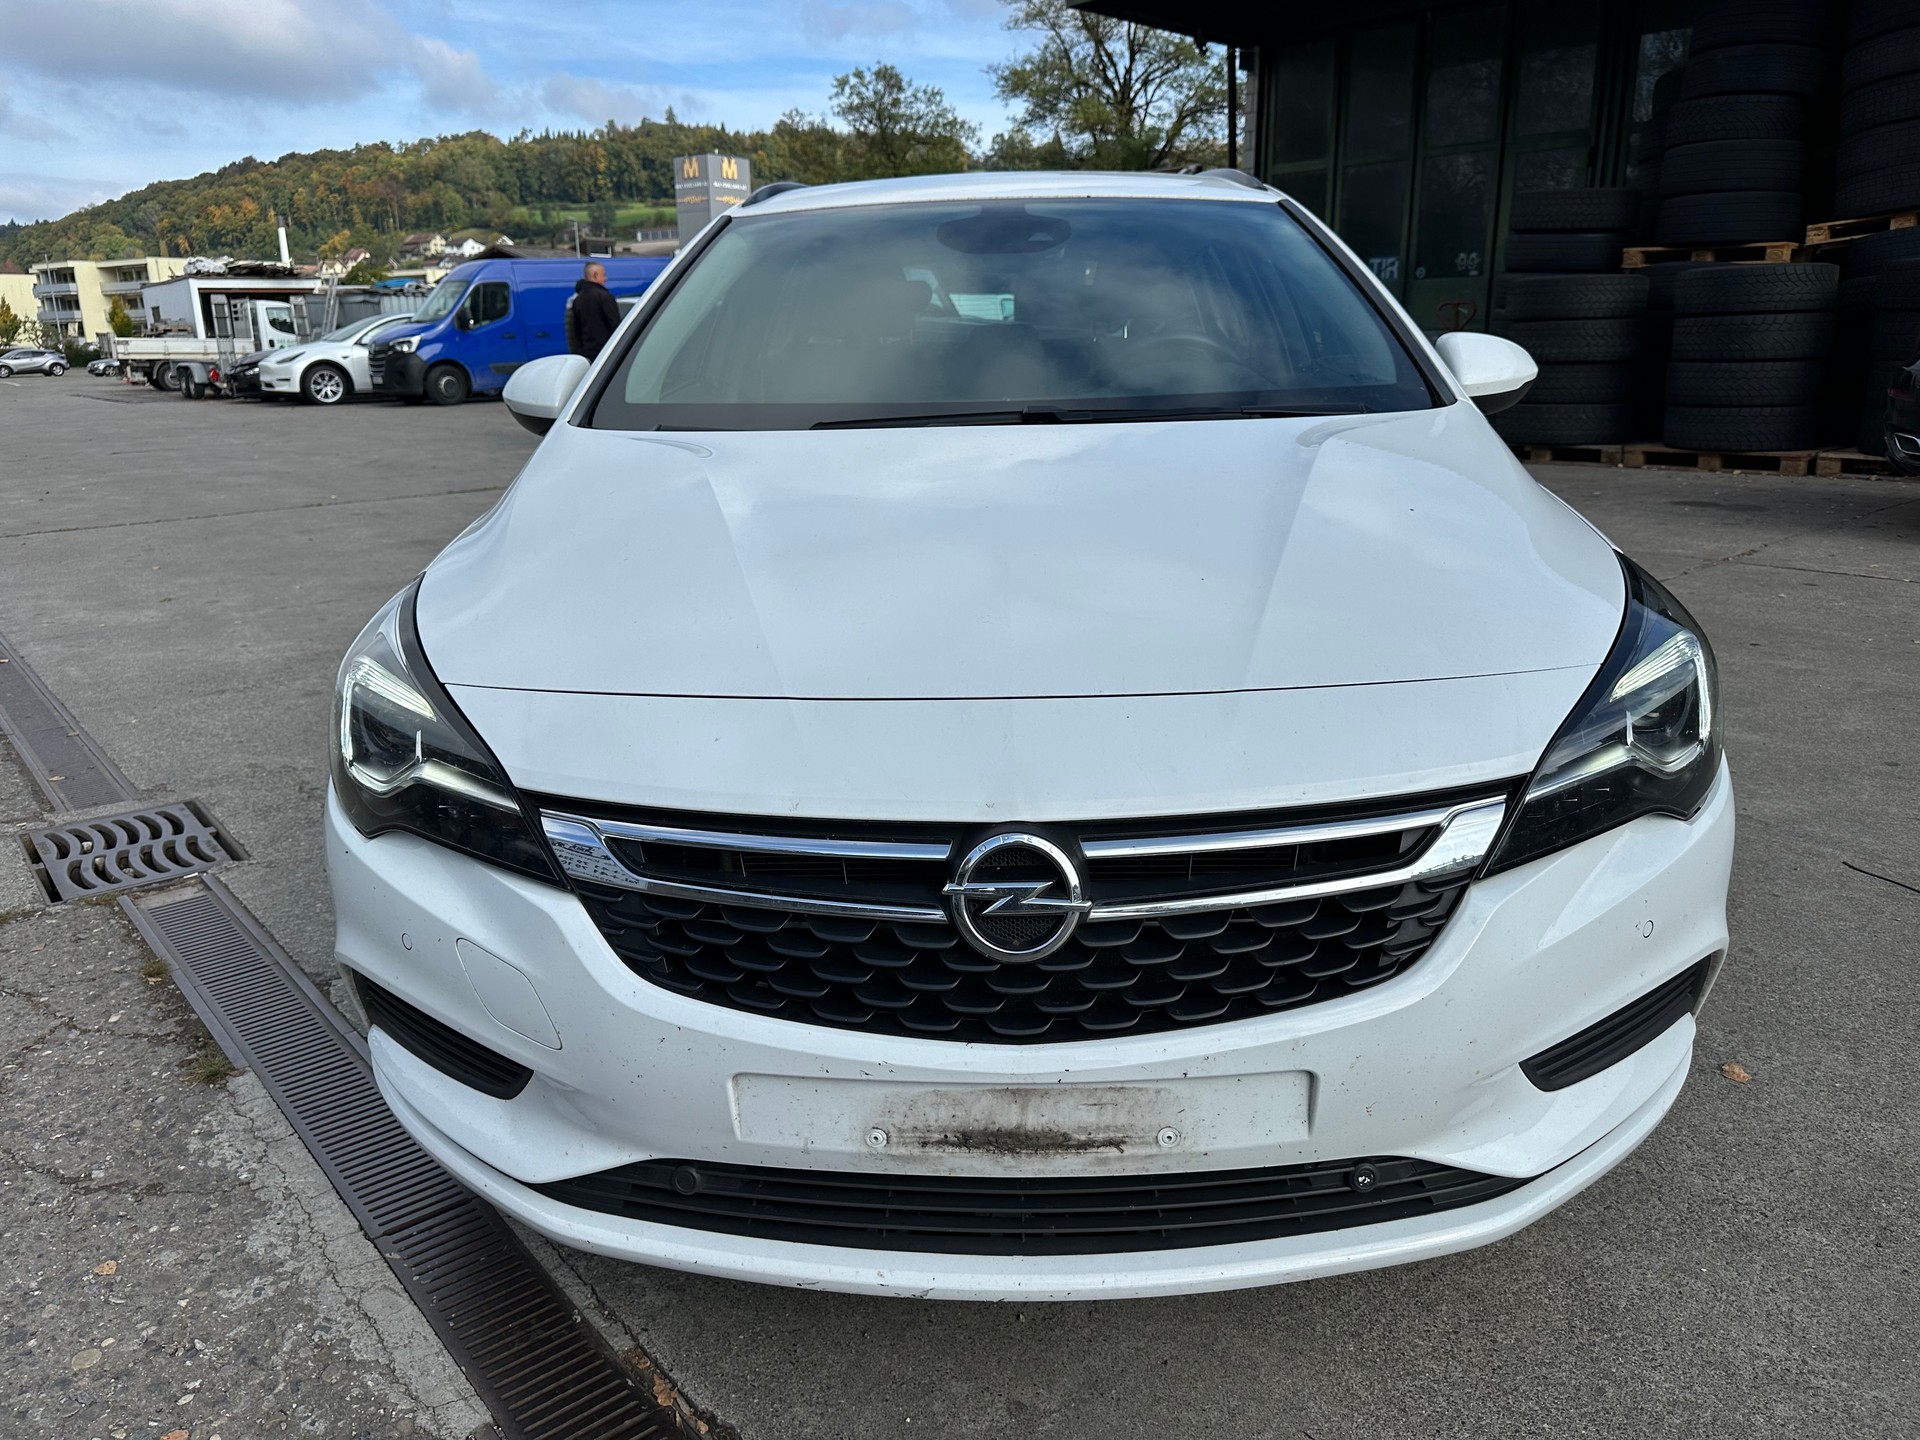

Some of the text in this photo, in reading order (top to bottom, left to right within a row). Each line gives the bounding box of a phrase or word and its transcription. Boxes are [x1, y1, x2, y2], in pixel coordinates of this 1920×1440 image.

[683, 157, 699, 178] M
[722, 156, 738, 179] M
[978, 835, 1055, 854] OPEL
